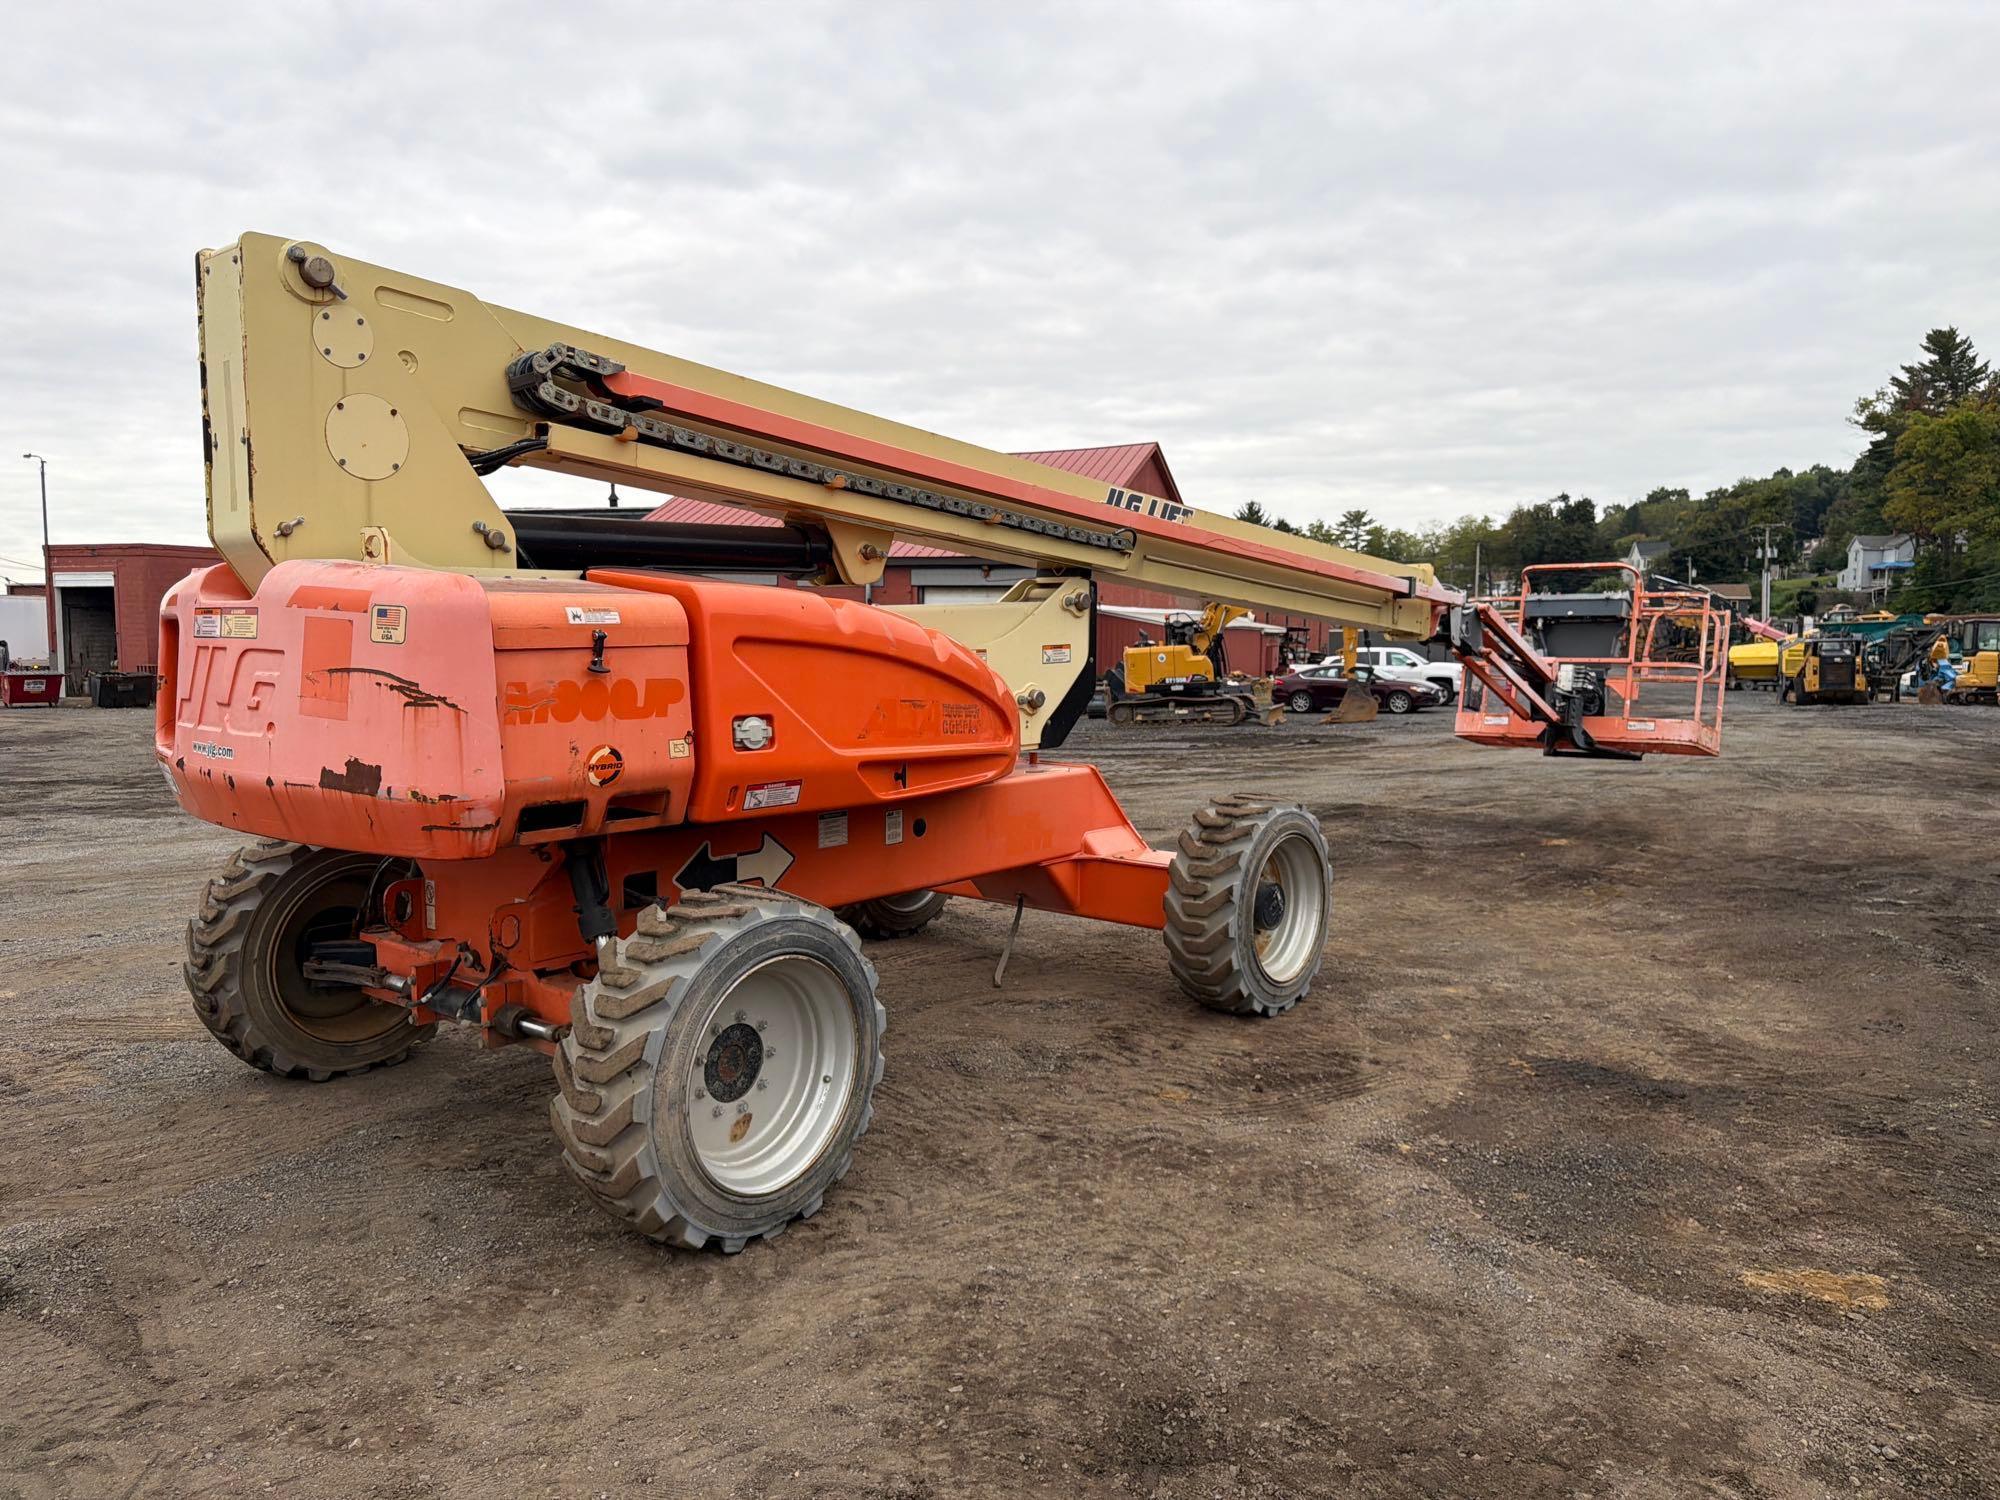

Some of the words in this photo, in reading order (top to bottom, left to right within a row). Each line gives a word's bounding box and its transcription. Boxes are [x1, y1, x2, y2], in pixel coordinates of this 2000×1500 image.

[177, 646, 285, 737] JLG
[192, 742, 233, 758] www.jlg.com
[587, 762, 623, 772] HYBRID
